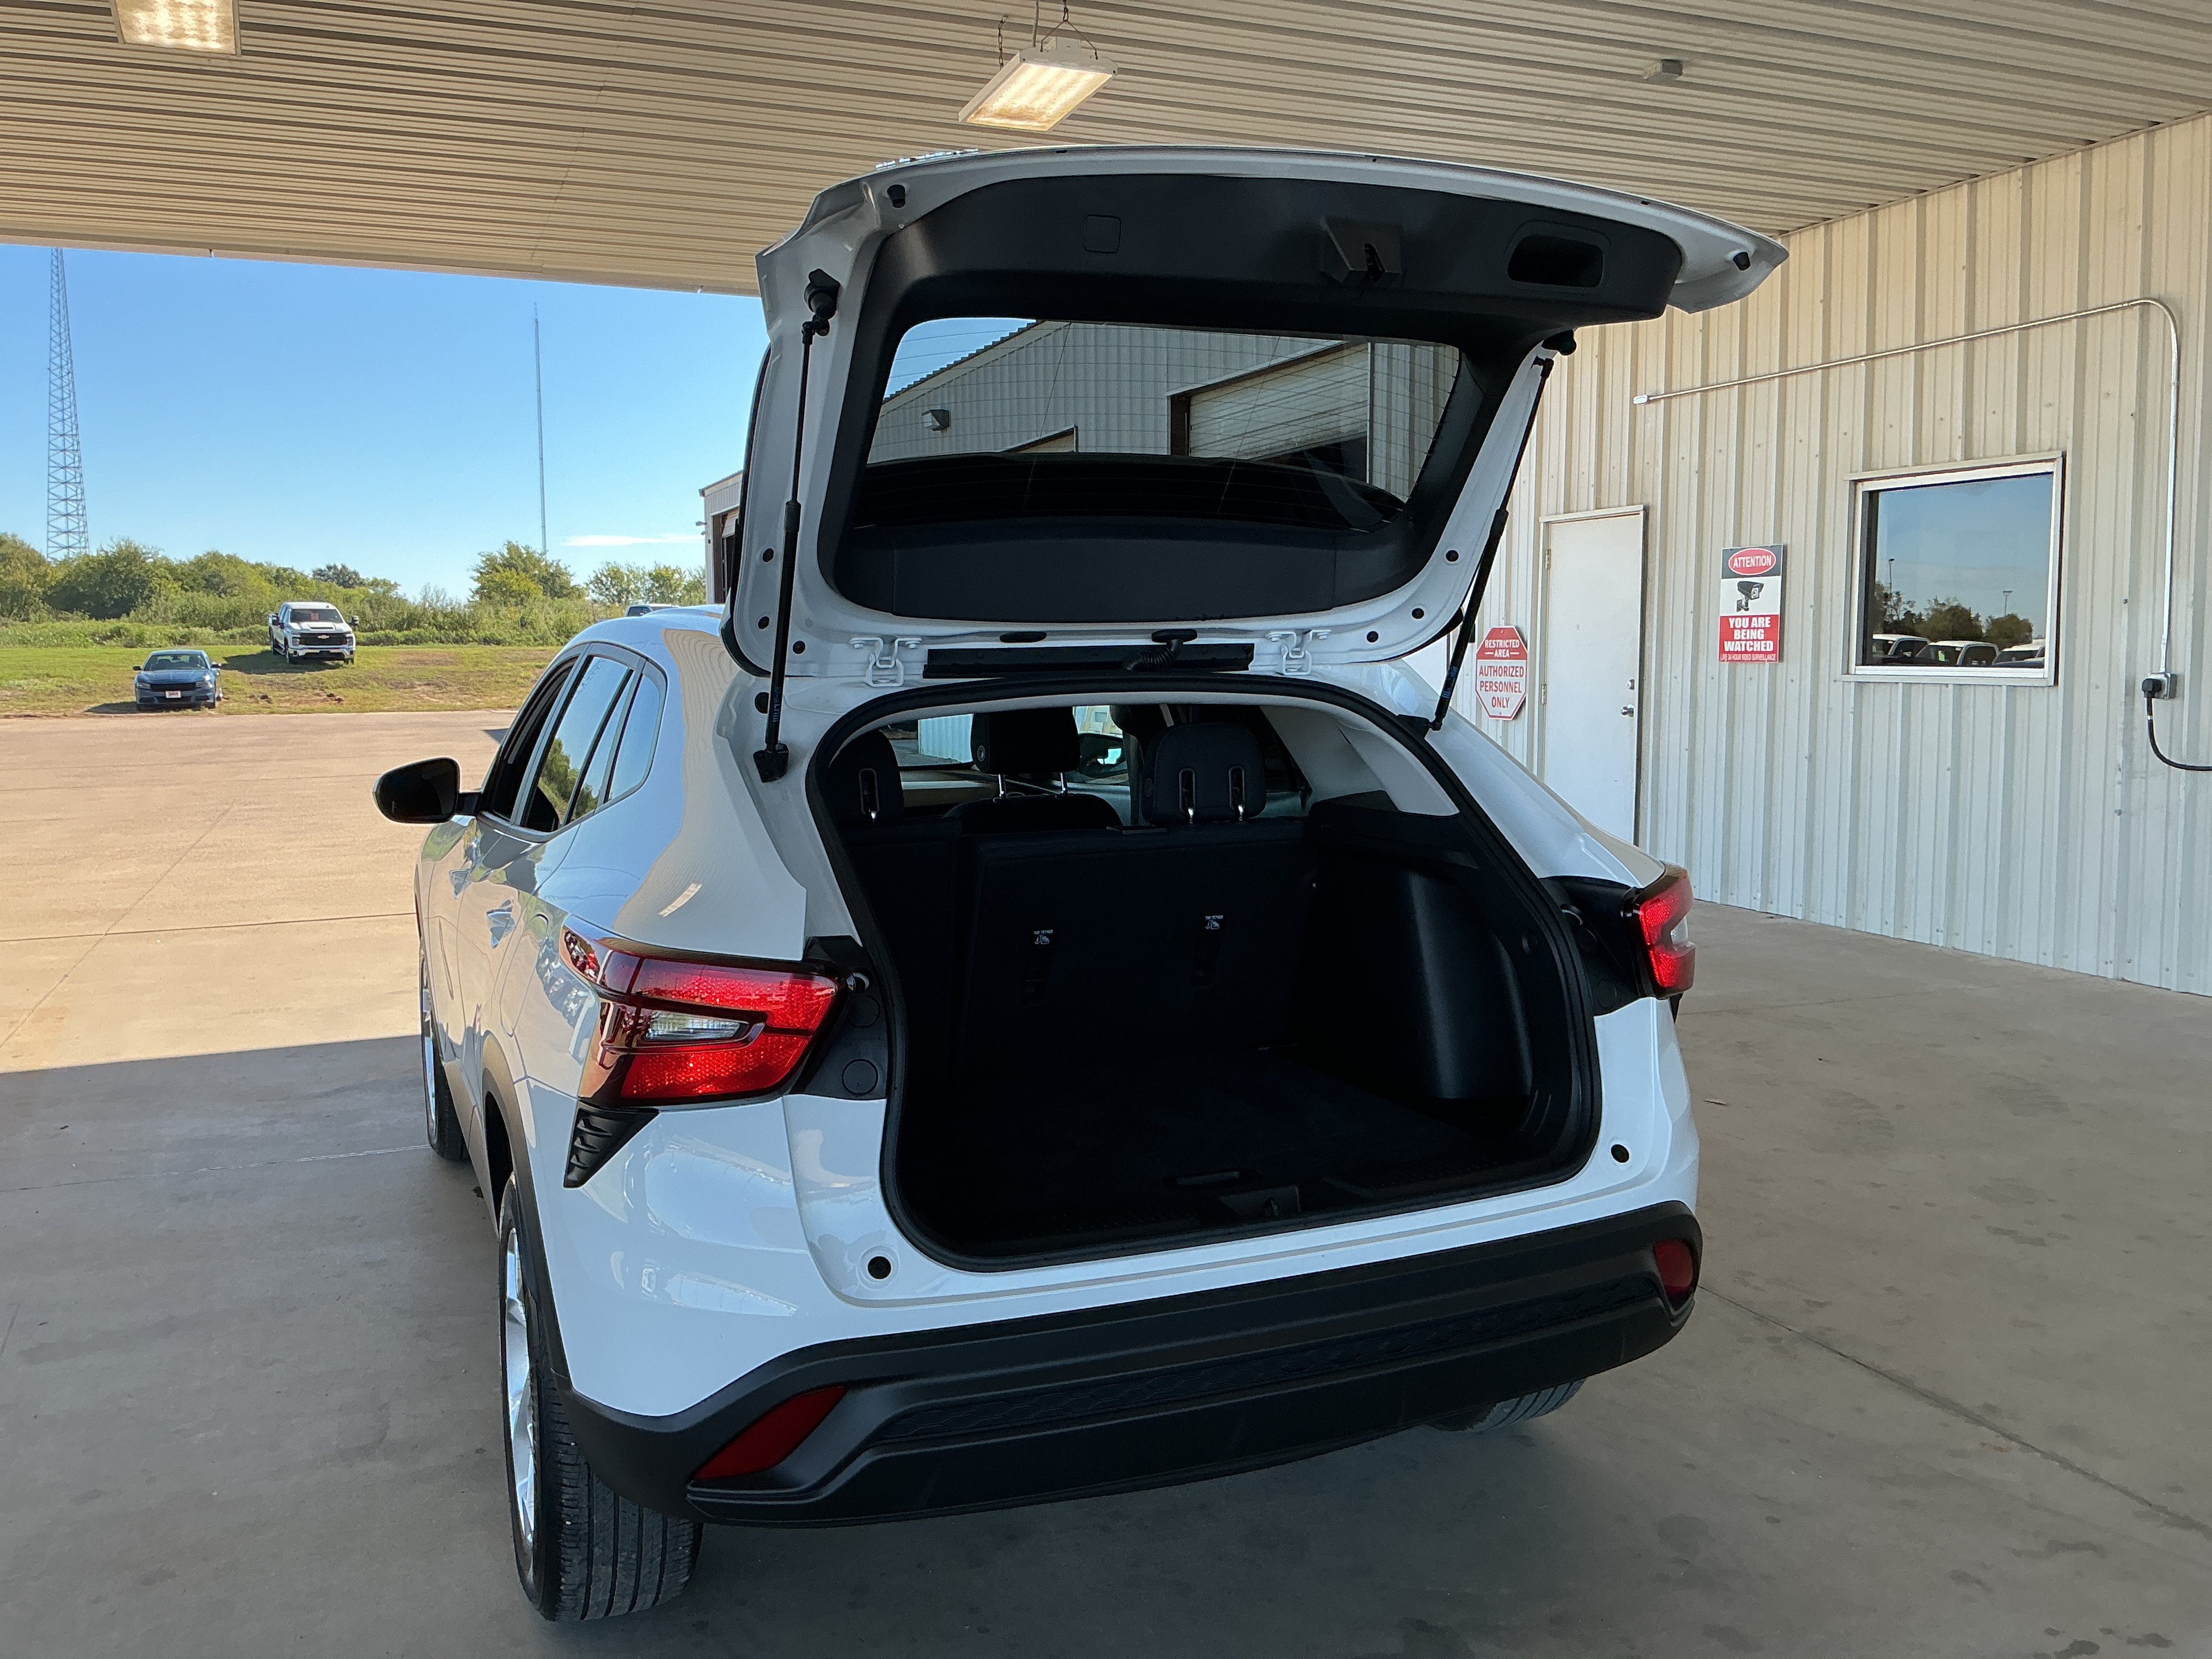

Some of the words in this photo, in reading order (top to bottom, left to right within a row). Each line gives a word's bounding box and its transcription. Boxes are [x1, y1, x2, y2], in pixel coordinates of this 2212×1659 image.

[1733, 555, 1771, 568] ATTENTION
[1729, 618, 1748, 629] YOU
[1751, 617, 1771, 628] ARE
[1734, 629, 1765, 640] BEING
[1485, 640, 1520, 648] RESTRICTED
[1724, 641, 1774, 652] WATCHED
[1494, 649, 1509, 657] AREA
[1479, 665, 1524, 678] AUTHORIZED
[1480, 681, 1522, 693] PERSONNEL
[1492, 696, 1510, 708] ONLY
